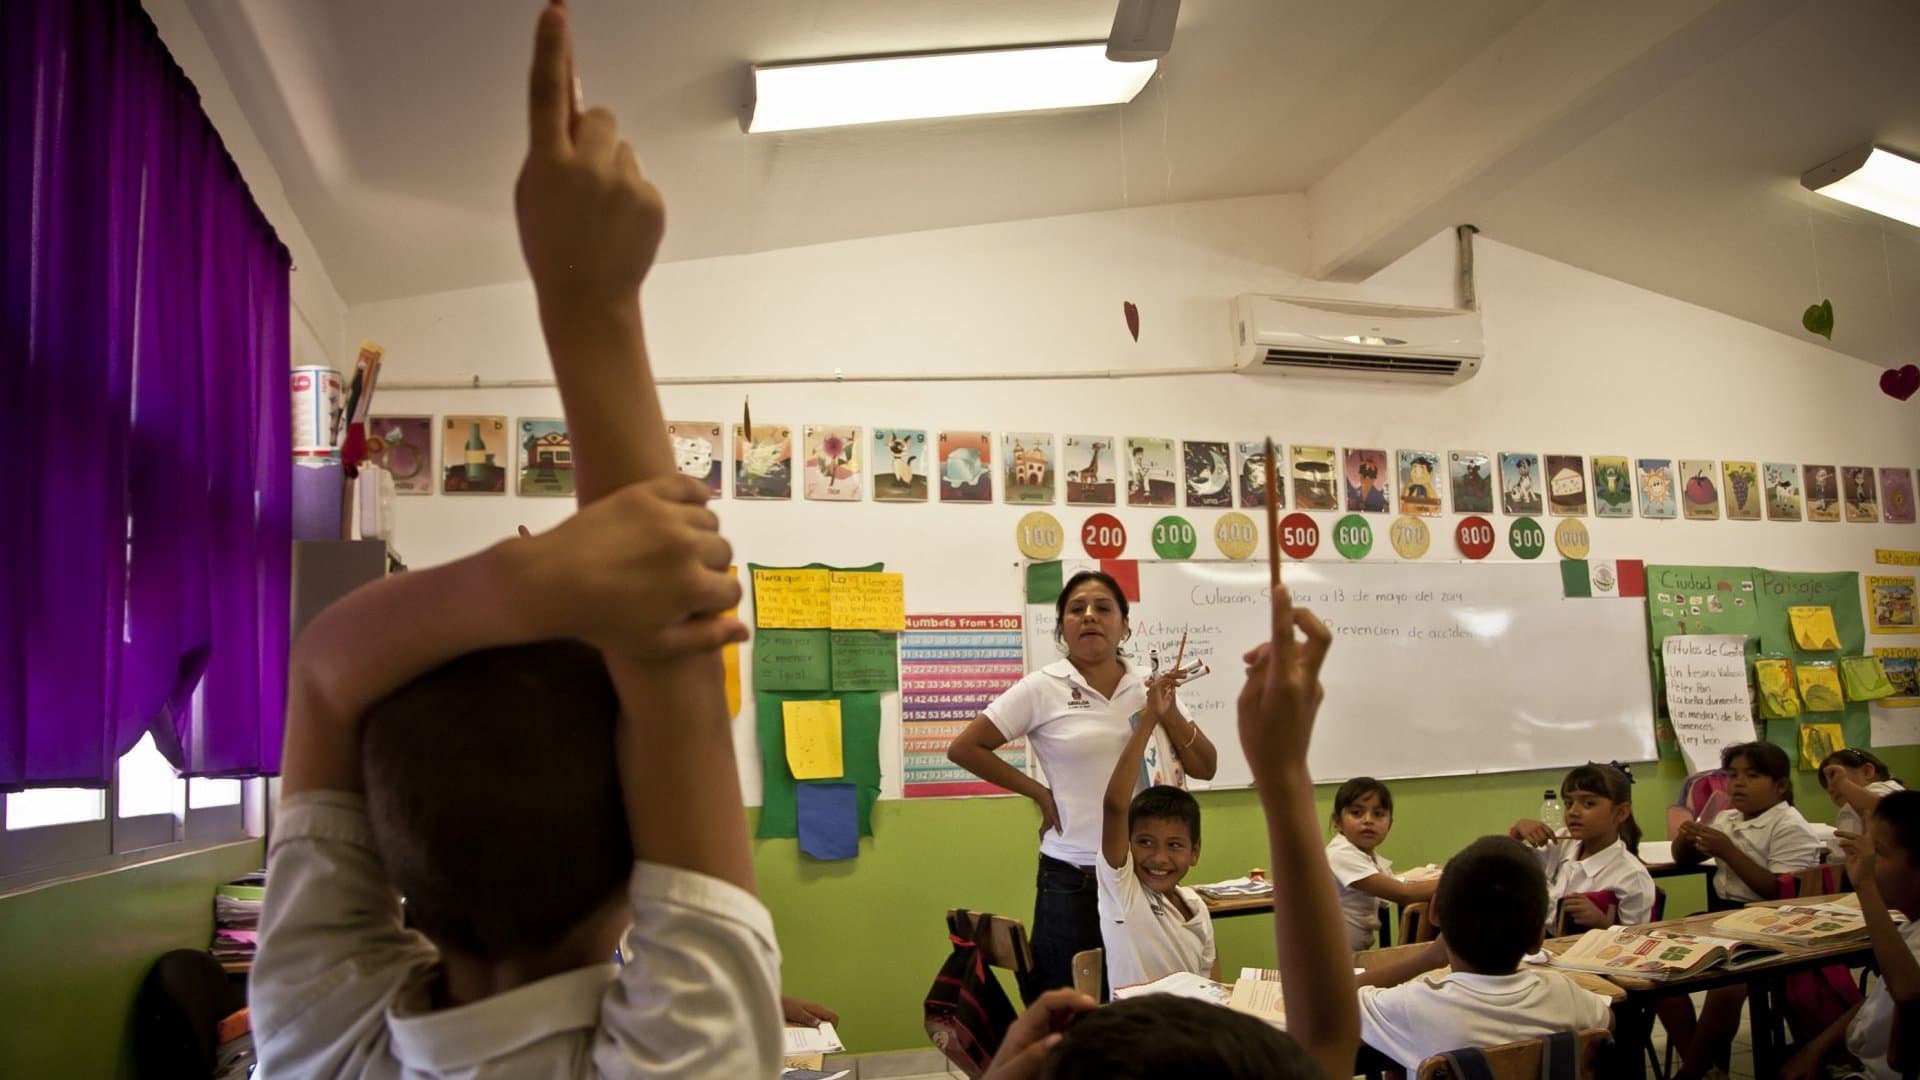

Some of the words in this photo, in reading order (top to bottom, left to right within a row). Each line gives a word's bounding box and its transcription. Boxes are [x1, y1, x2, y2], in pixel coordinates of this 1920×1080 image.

[1024, 526, 1058, 548] 100
[1085, 526, 1123, 547] 200
[1155, 524, 1192, 545] 300
[1218, 524, 1251, 543] 400
[1284, 527, 1317, 547] 500
[1339, 526, 1370, 545] 600
[1396, 525, 1424, 545] 700
[1461, 525, 1491, 545] 800
[1512, 528, 1542, 548] 900
[1661, 571, 1711, 592] Ciudad
[1260, 587, 1312, 604] Sloa
[1334, 589, 1345, 602] 13
[1353, 590, 1370, 602] de
[1376, 591, 1408, 605] mayo
[1415, 590, 1433, 602] del
[960, 617, 987, 628] From
[989, 618, 1018, 628] 1-100
[1136, 621, 1223, 637] Actividades
[1408, 625, 1424, 638] de
[1705, 643, 1718, 657] de
[1669, 665, 1682, 678] Un
[914, 680, 925, 689] 32
[927, 680, 937, 689] 33
[939, 680, 950, 689] 34
[951, 680, 962, 689] 35
[976, 679, 987, 688] 37
[903, 695, 913, 704] 41
[914, 695, 926, 704] 42
[927, 695, 938, 704] 43
[939, 695, 951, 704] 44
[951, 695, 963, 704] 45
[964, 694, 976, 703] 46
[976, 694, 987, 703] 47
[903, 711, 913, 719] 51
[914, 711, 927, 719] 52
[927, 711, 938, 719] 53
[939, 711, 952, 719] 54
[952, 711, 964, 719] 55
[964, 710, 977, 718] 56
[1721, 712, 1732, 722] de
